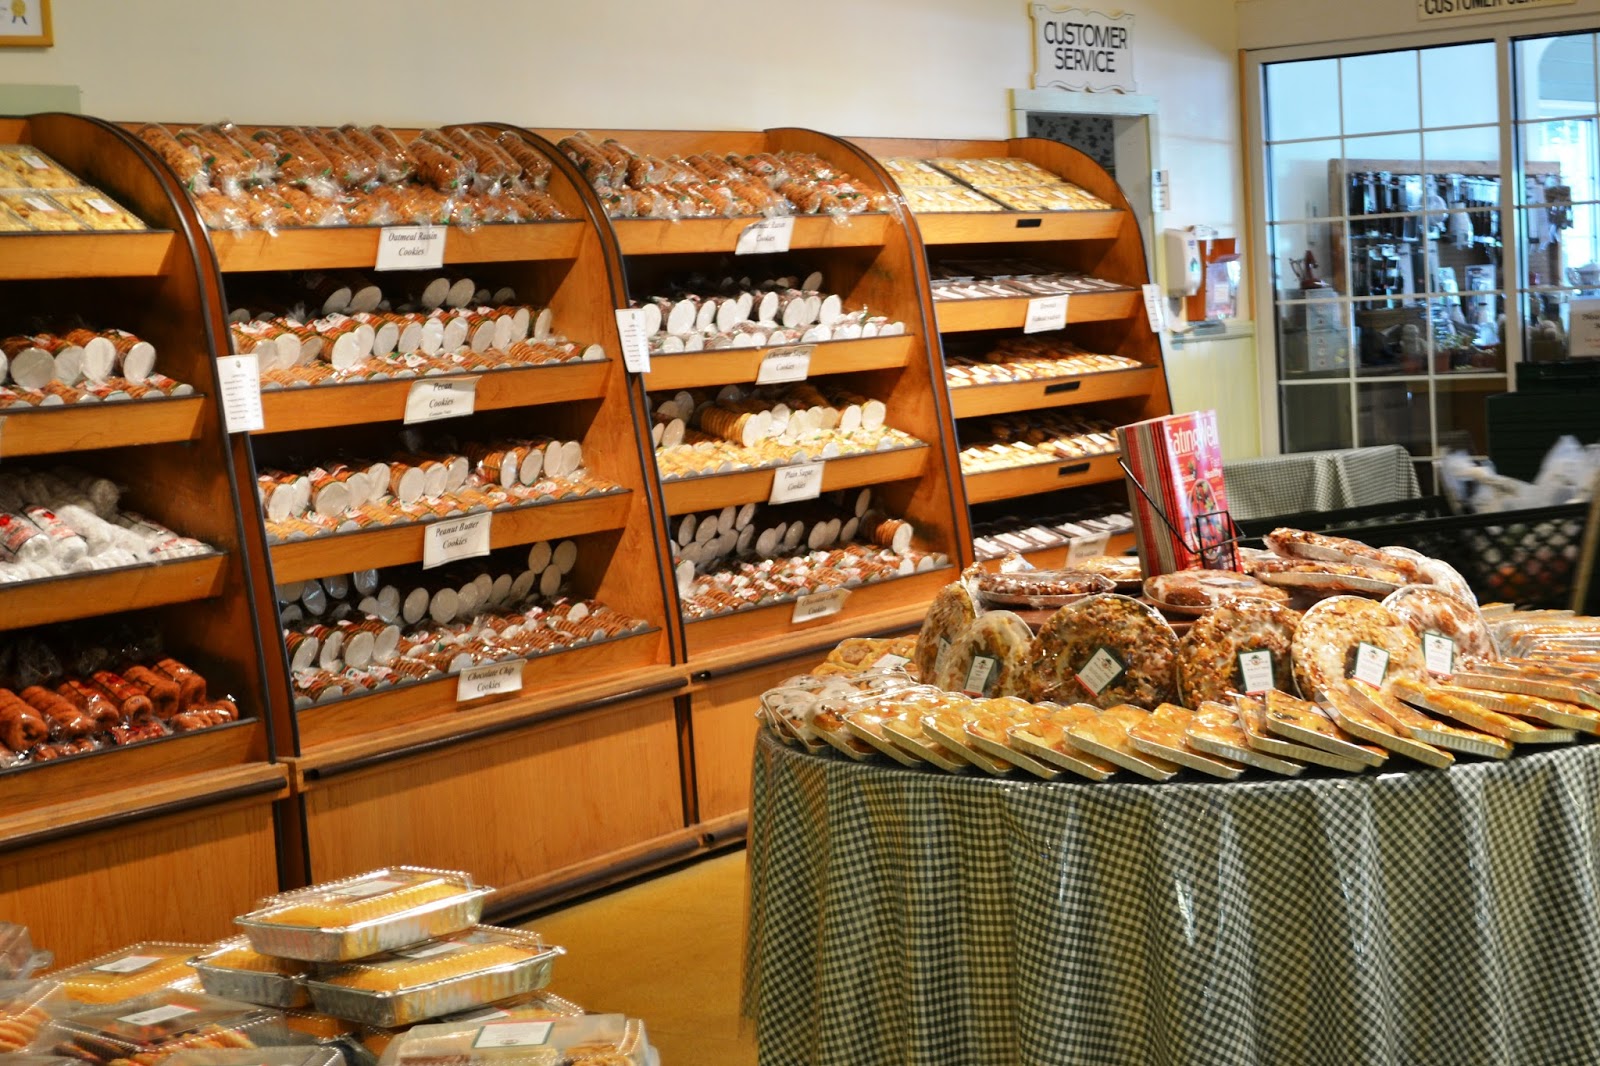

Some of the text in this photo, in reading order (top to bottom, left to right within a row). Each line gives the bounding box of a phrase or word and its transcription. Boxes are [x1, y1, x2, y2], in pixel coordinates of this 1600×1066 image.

[1044, 21, 1128, 49] CUSTOMER
[1055, 48, 1115, 73] SERVICE
[388, 232, 417, 241] Oatmeal
[398, 247, 424, 256] Cookies
[433, 382, 453, 391] Pecan
[428, 397, 454, 408] Cookies
[435, 521, 479, 537] Peanut Butter
[442, 537, 468, 549] Cookies
[467, 668, 498, 681] Chocolate
[477, 680, 501, 692] Cookies
